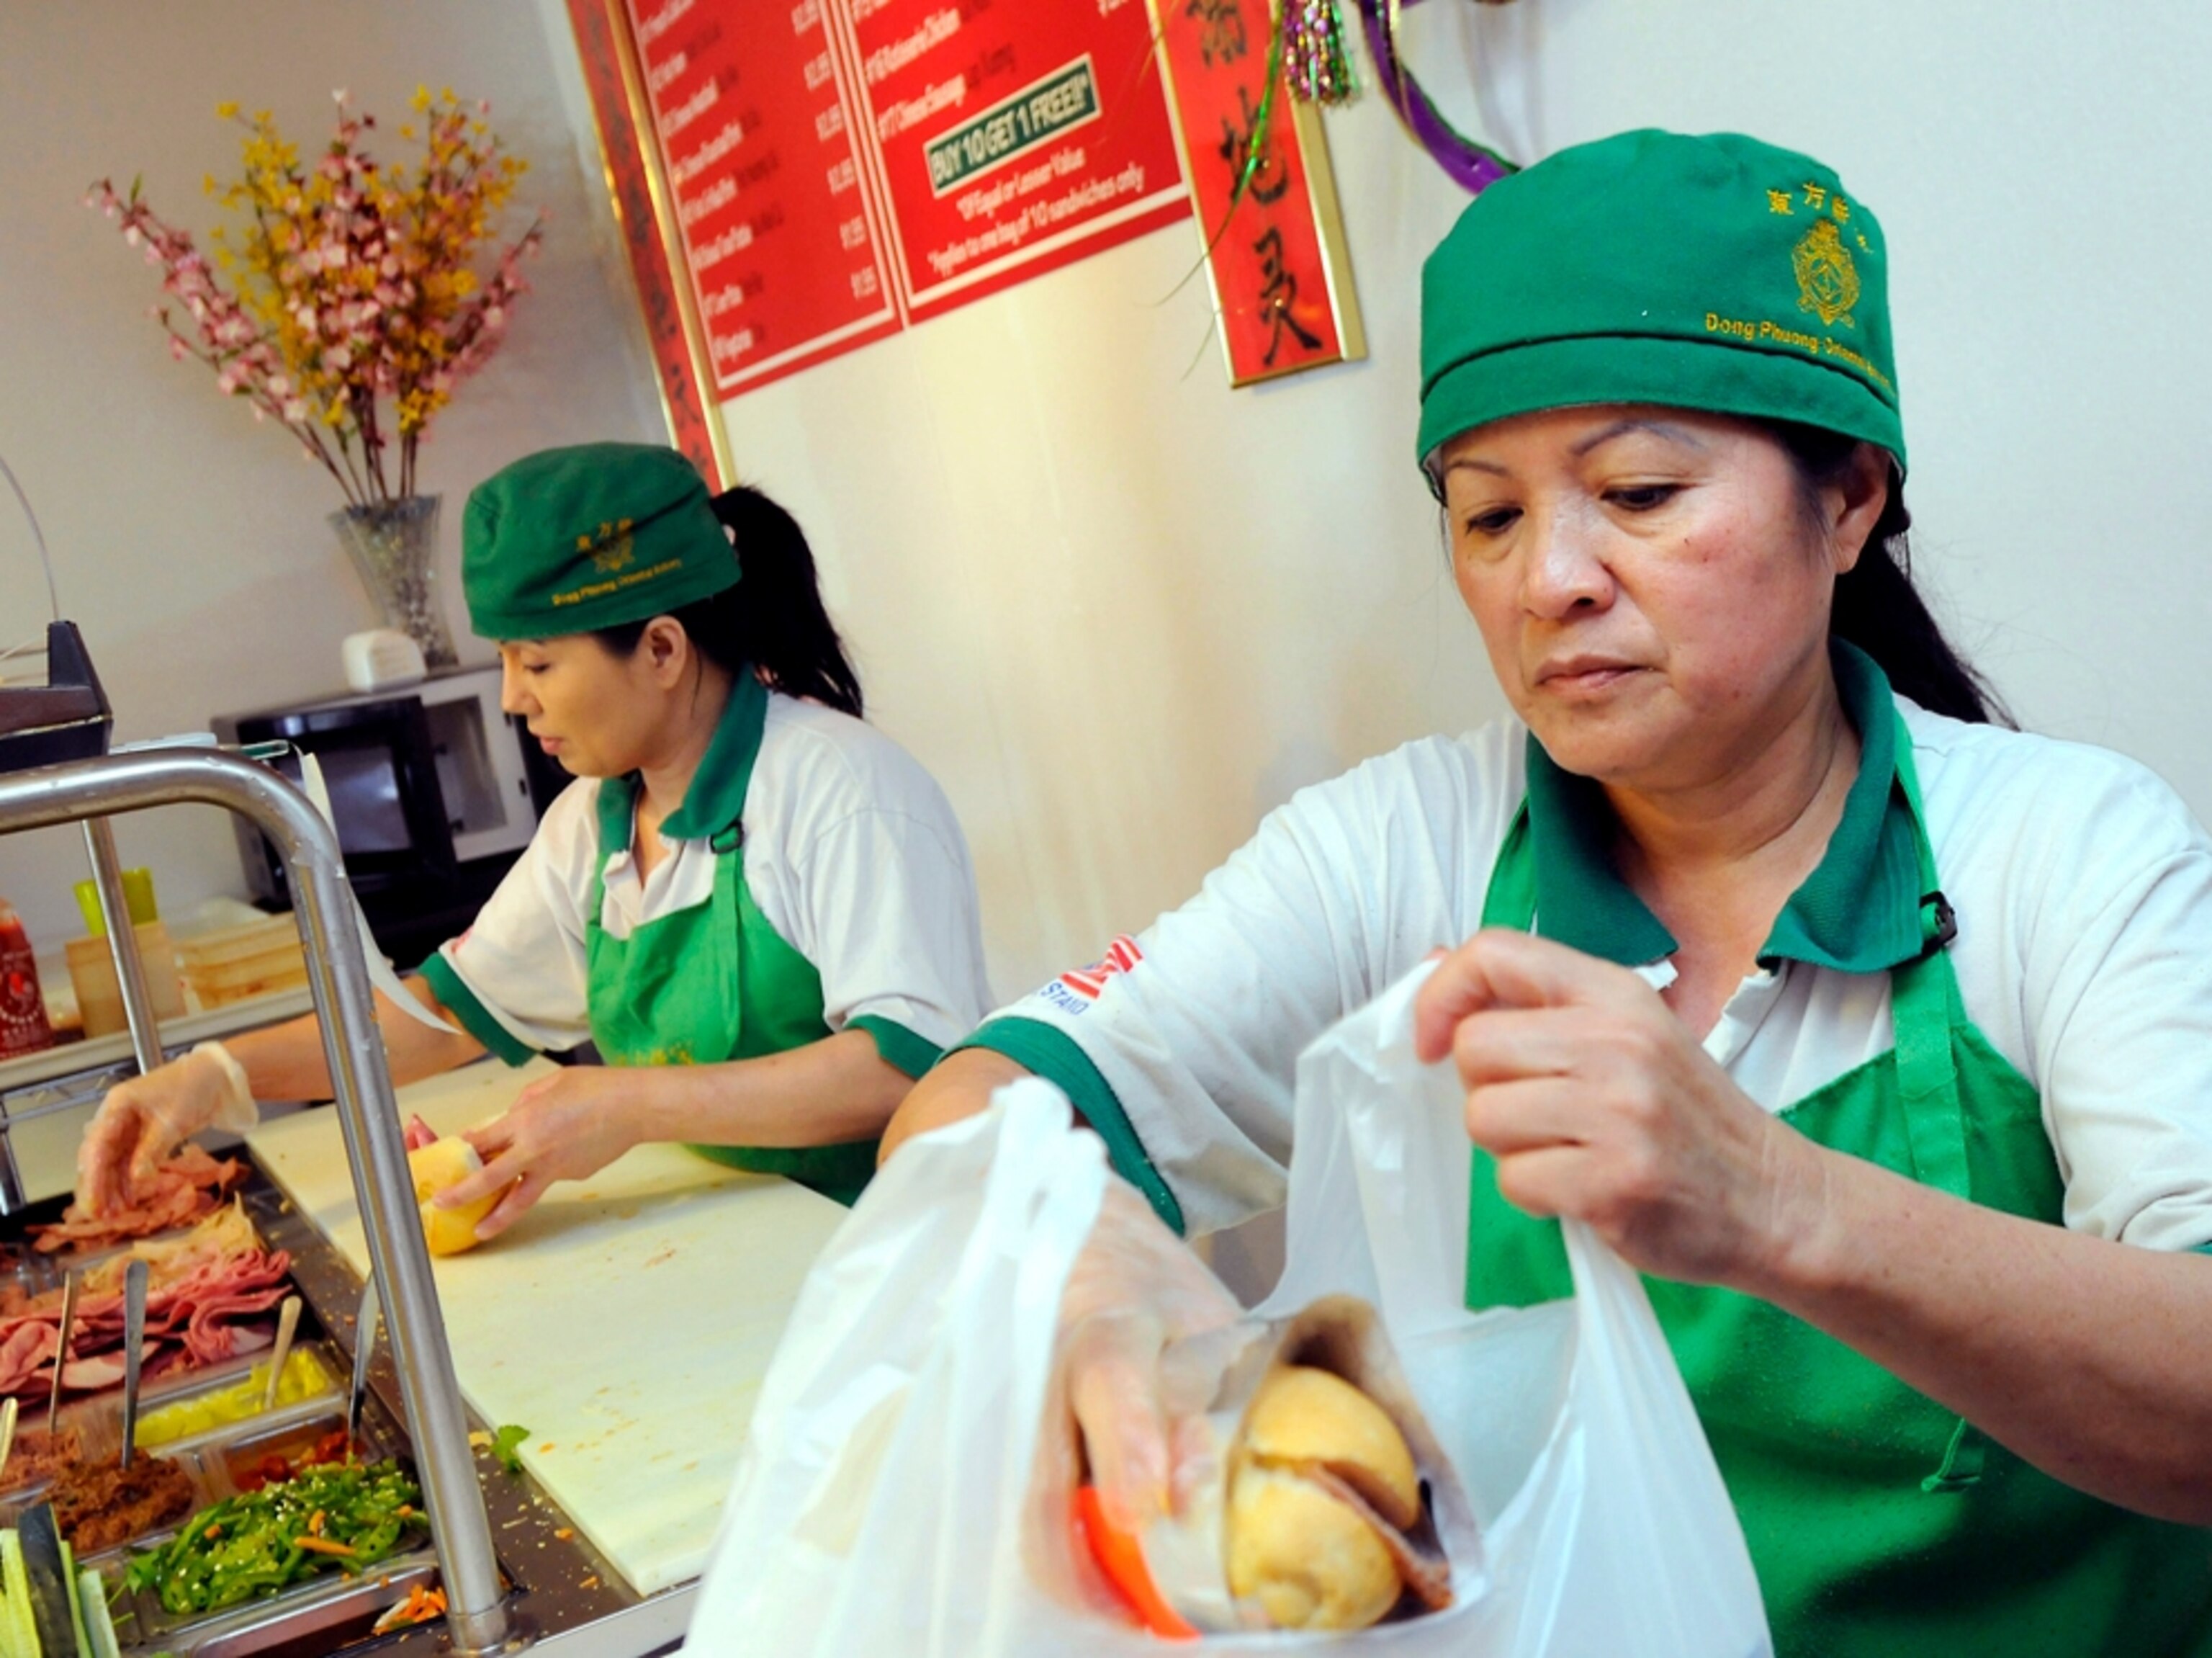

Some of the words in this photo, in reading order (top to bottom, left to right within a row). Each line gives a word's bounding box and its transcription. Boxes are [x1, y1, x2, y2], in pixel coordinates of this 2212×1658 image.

[930, 140, 961, 184] BUY
[963, 128, 986, 166] 10
[985, 110, 1017, 156] GET
[1017, 104, 1030, 138] 1
[1050, 146, 1085, 176] Value
[1030, 200, 1048, 228] 10
[1048, 178, 1117, 222] sandwiches
[1116, 161, 1145, 193] only
[1706, 313, 1755, 341] Dong
[1760, 321, 1818, 354] Phuong
